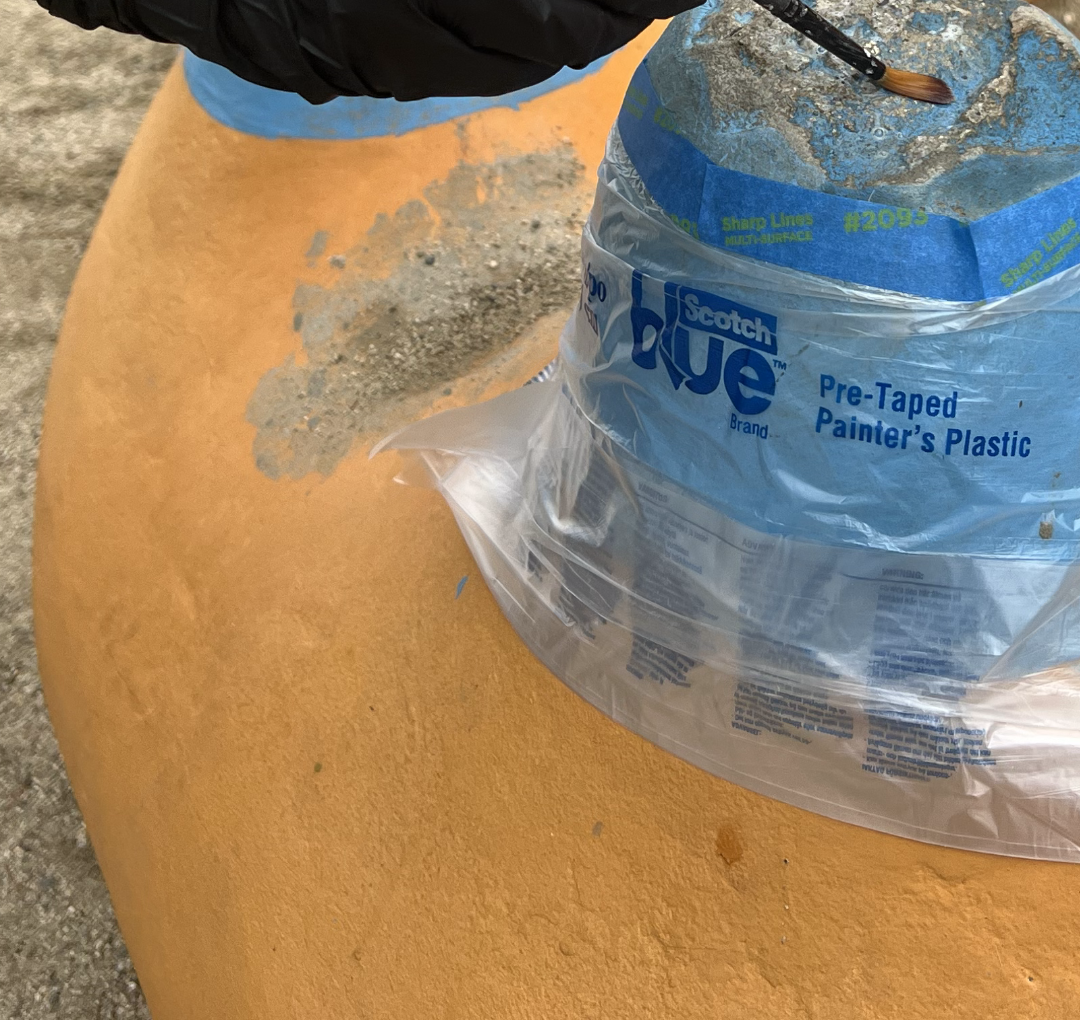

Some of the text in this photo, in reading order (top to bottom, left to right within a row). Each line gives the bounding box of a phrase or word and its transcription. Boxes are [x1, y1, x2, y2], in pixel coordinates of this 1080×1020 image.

[722, 212, 814, 232] Sharp Lines
[843, 207, 929, 233] #2093
[1001, 217, 1077, 288] Sharp Lines
[630, 269, 776, 415] blue
[683, 293, 773, 346] Scotch
[819, 373, 958, 420] Pre-Taped
[730, 413, 769, 440] Brand
[815, 406, 1032, 458] Painter's Plastic
